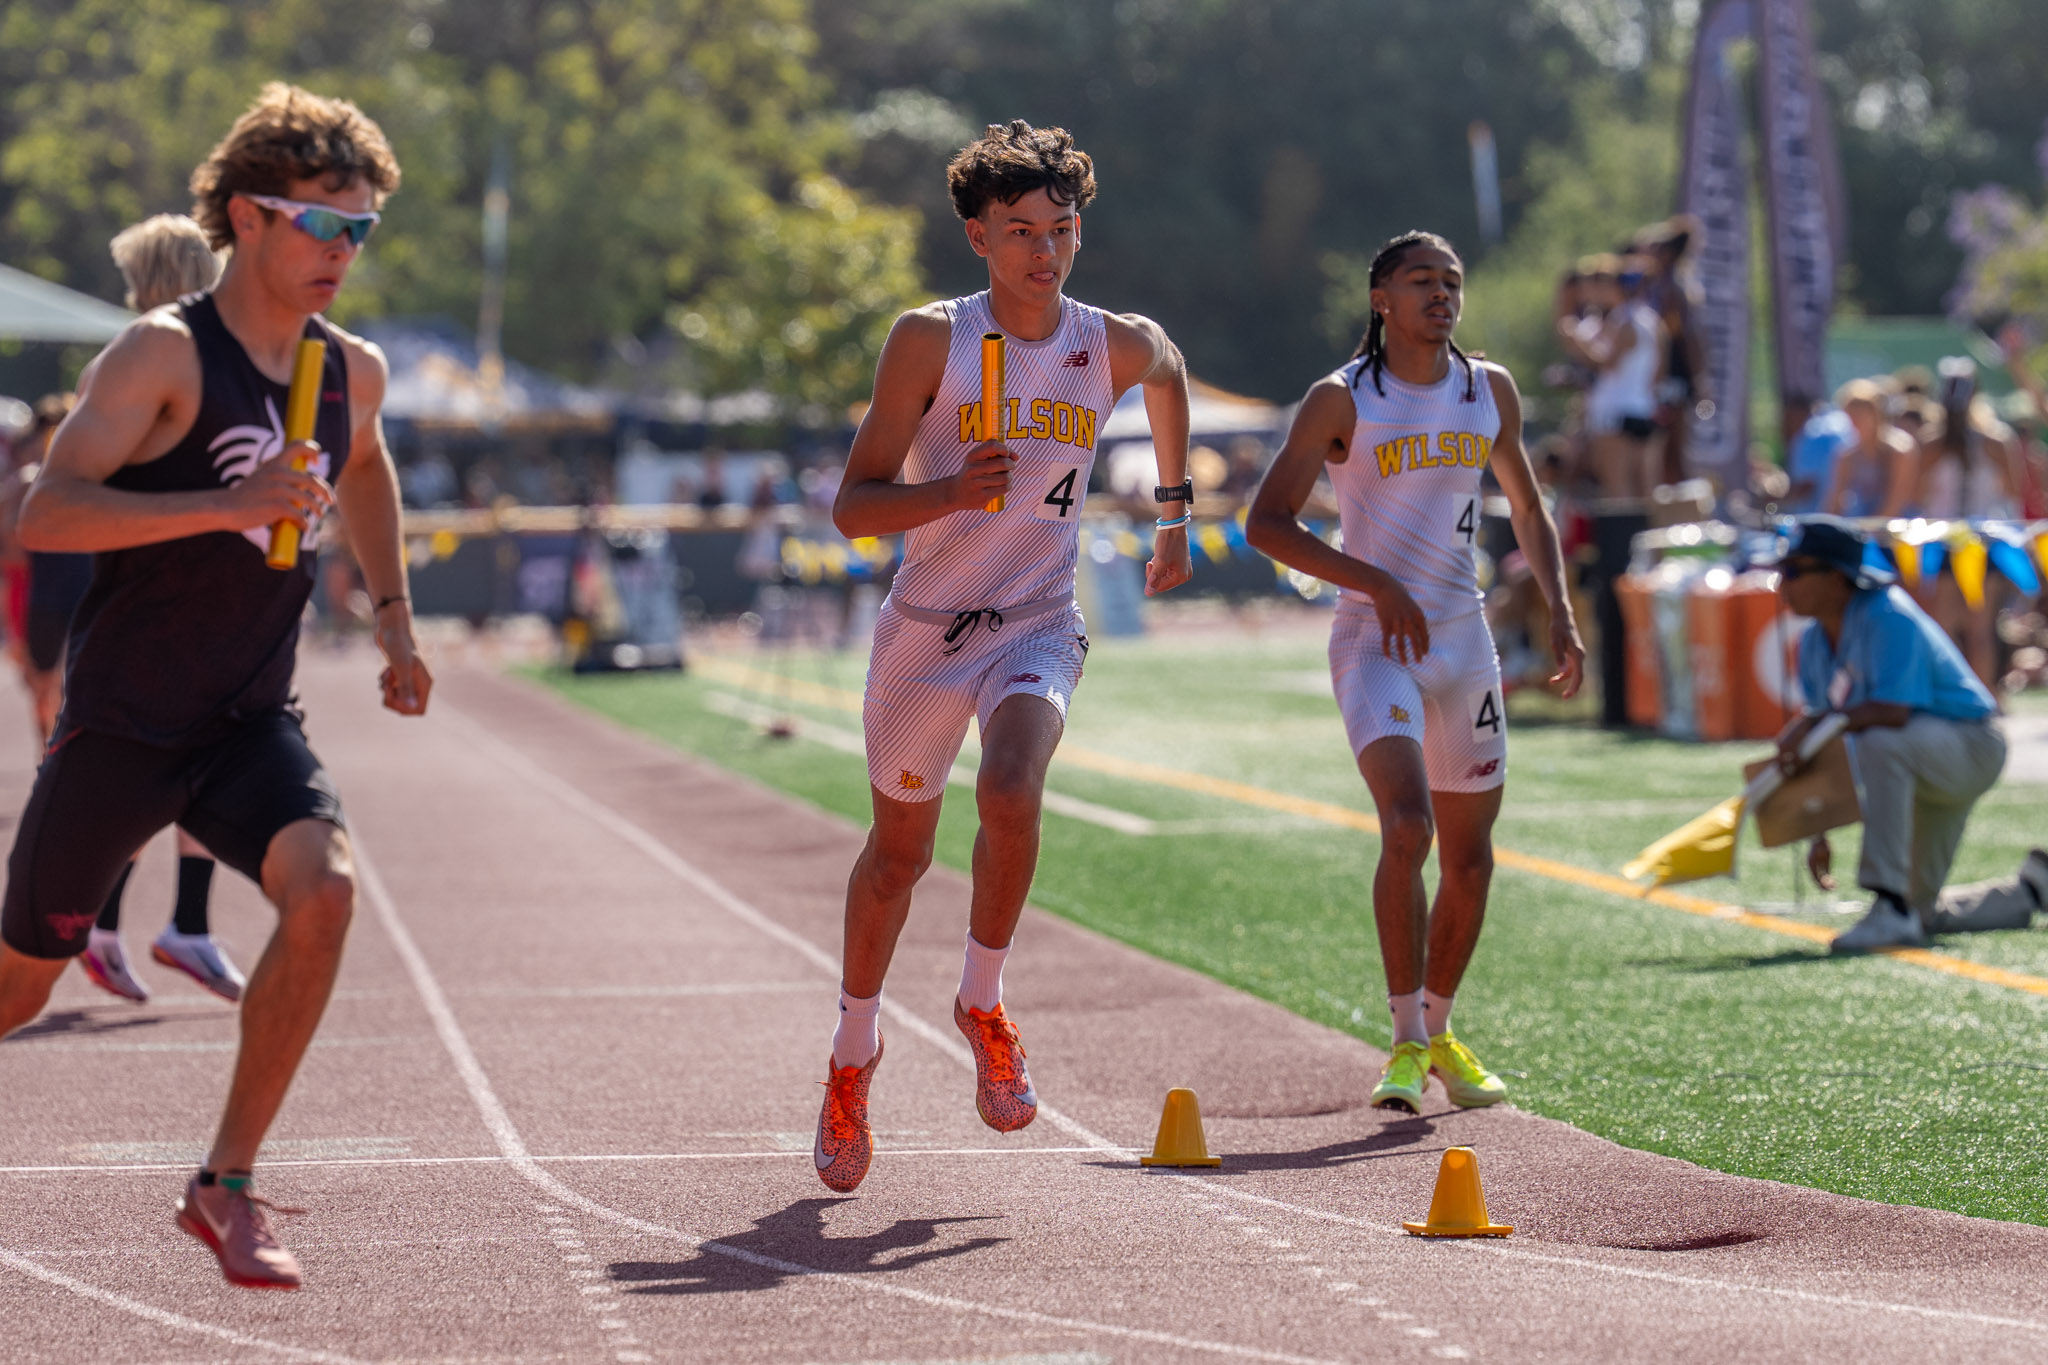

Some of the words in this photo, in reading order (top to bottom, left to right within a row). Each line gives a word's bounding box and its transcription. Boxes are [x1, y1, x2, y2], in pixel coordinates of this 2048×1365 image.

[958, 398, 1096, 450] WLSON
[991, 409, 999, 439] THERN
[1374, 431, 1493, 479] WILSON
[1044, 468, 1078, 518] 4
[1456, 498, 1475, 544] 4
[1475, 690, 1500, 734] 4
